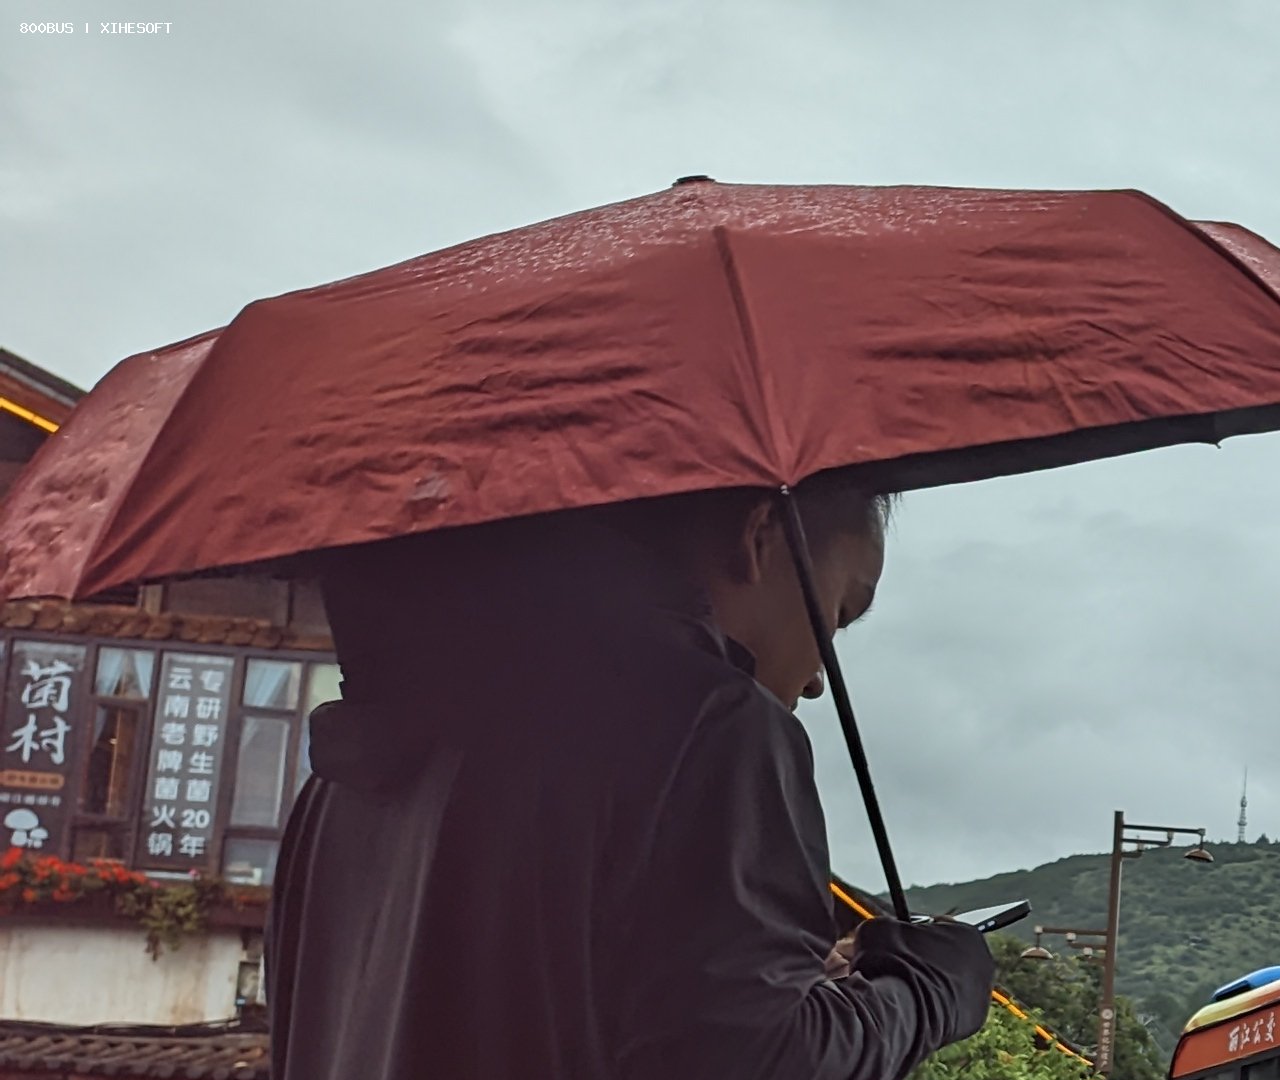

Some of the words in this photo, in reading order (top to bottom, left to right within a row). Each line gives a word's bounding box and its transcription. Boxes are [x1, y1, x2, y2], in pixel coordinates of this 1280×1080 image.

[4, 658, 75, 765] 菌村
[147, 665, 194, 857] 云南老牌菌火锅
[179, 669, 226, 858] 专研野生菌20年
[1228, 1012, 1276, 1053] 丽江公交
